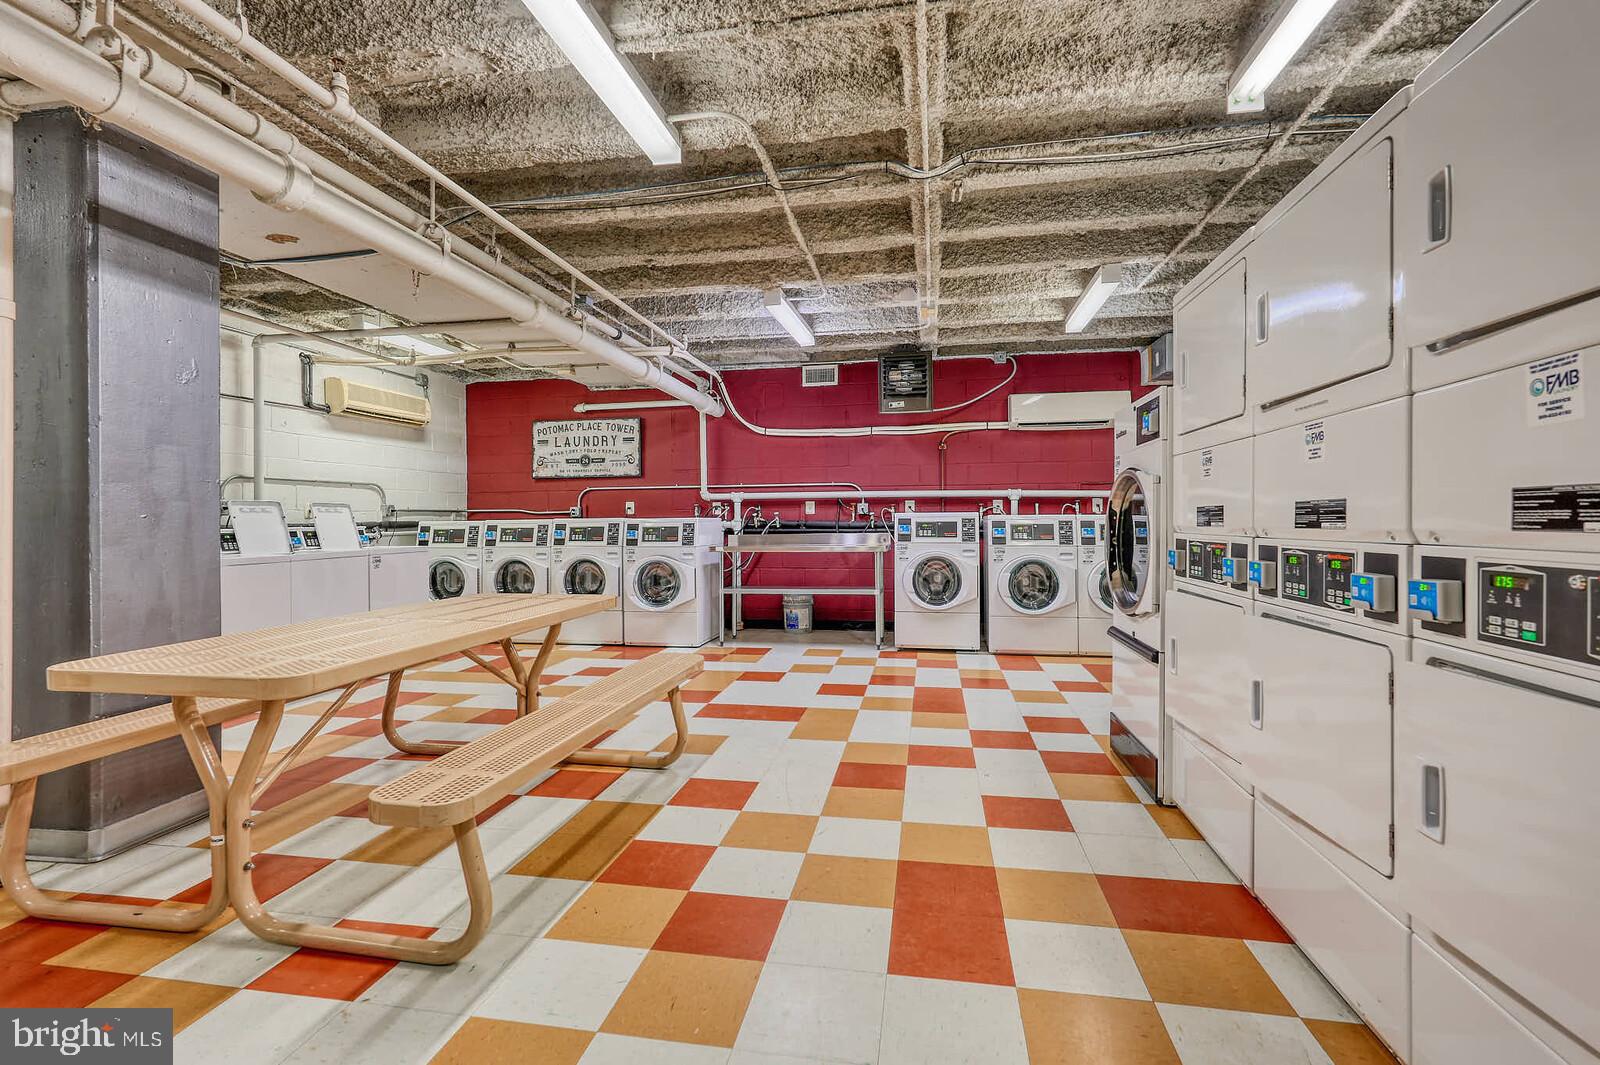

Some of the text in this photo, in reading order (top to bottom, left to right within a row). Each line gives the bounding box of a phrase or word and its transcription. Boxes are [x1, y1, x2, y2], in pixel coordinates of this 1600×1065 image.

[1546, 368, 1580, 394] FMB
[537, 422, 635, 437] POTOMAC PLACE TOWER
[554, 435, 617, 448] LAUNDRY
